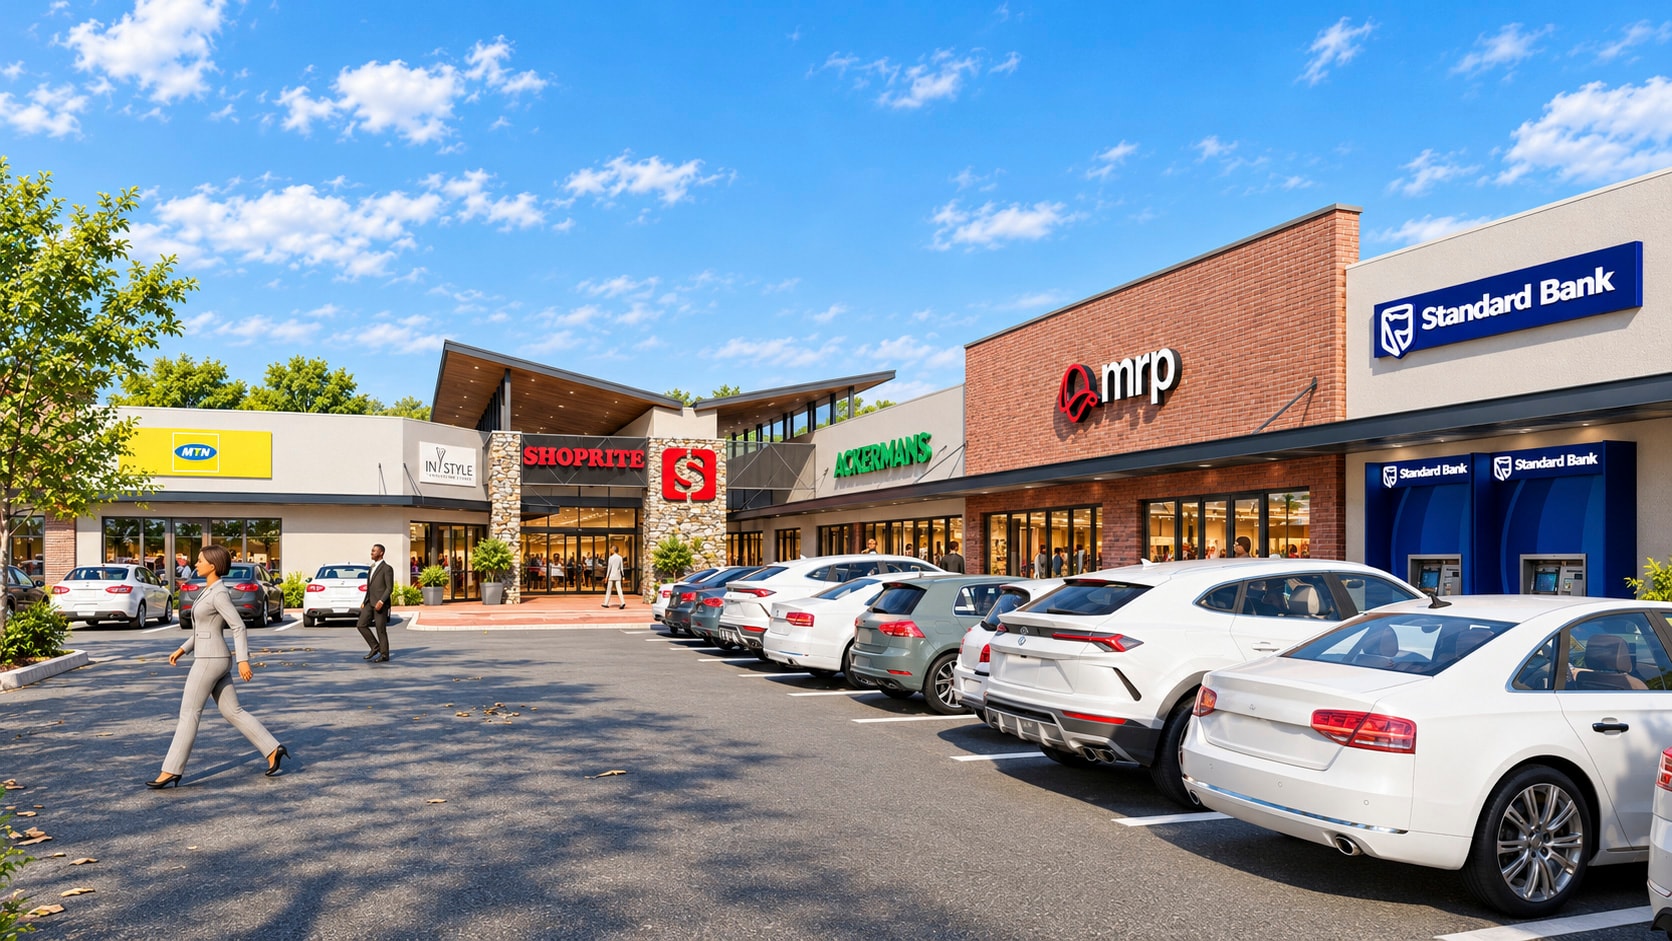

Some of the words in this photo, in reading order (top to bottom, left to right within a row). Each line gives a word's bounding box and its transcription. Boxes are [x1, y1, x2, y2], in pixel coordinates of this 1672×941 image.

[1421, 284, 1532, 331] Standard
[1540, 266, 1615, 306] Bank
[1101, 347, 1182, 405] mrp
[181, 447, 211, 457] MTN
[523, 446, 645, 468] SHOPRITE
[833, 432, 932, 478] ACKERMANS
[1514, 454, 1565, 471] Standard
[1566, 452, 1599, 467] Bank
[443, 462, 473, 477] STYLE
[1399, 465, 1441, 479] Standard
[1442, 462, 1468, 474] Bank
